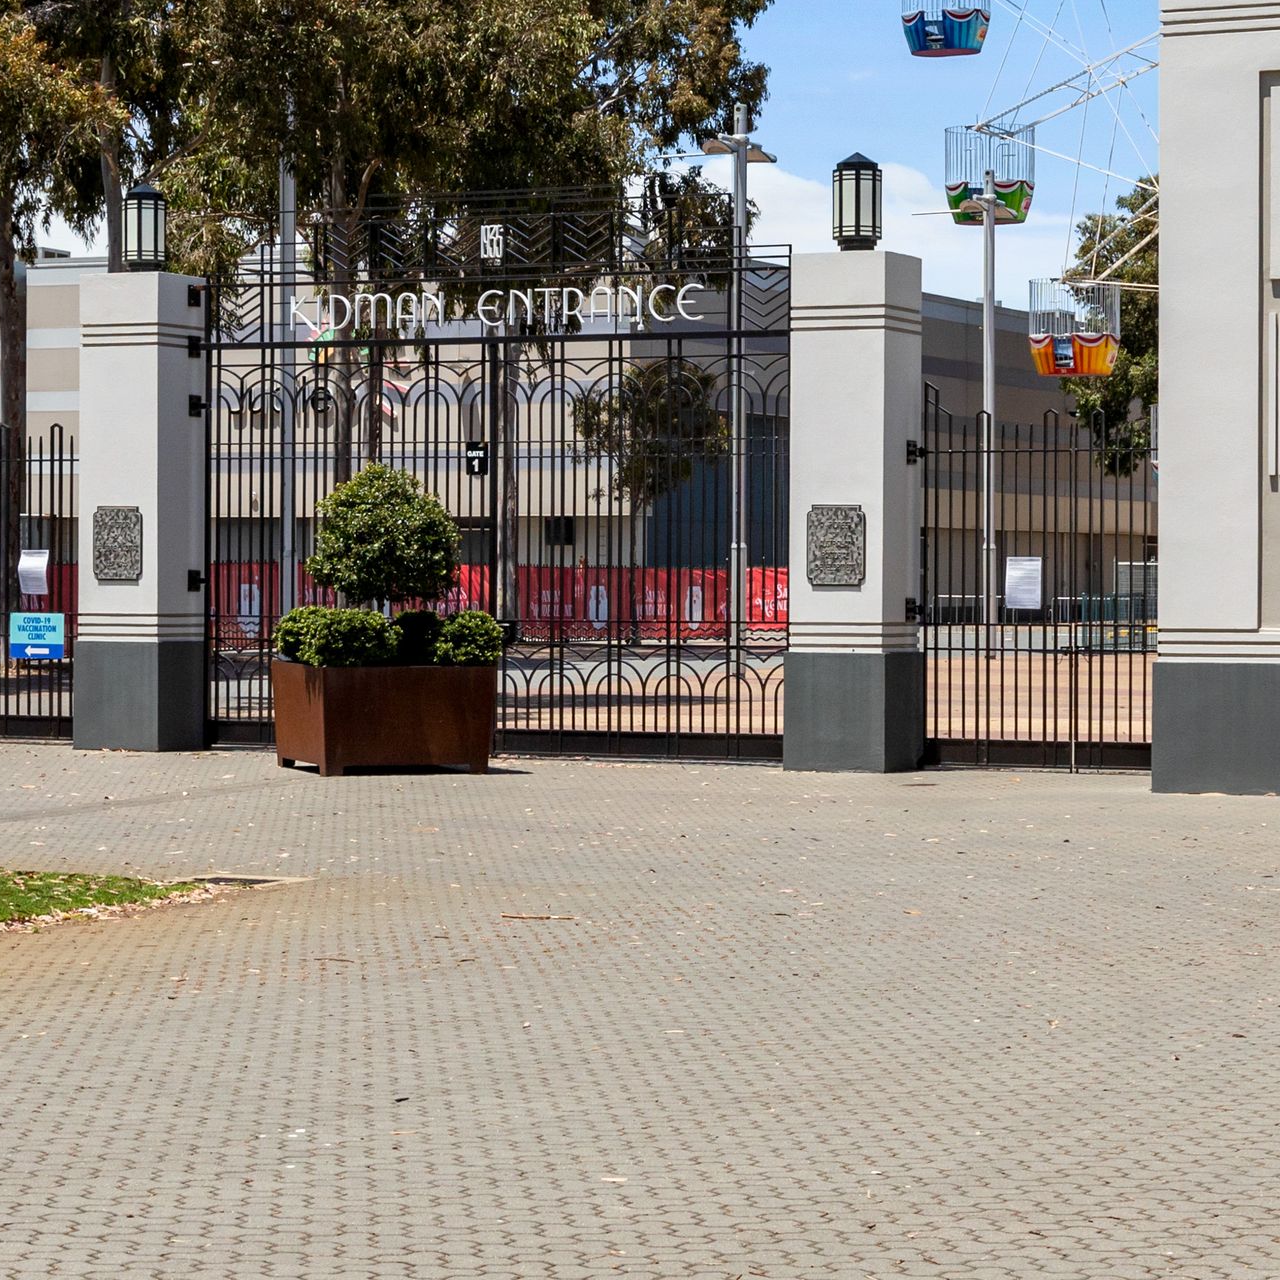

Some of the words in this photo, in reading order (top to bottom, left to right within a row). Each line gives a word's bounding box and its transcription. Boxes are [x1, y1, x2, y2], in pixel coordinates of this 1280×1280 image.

[289, 291, 446, 331] KIDMAN
[477, 283, 706, 327] ENTRANCE
[472, 458, 479, 472] 1
[23, 616, 51, 625] COVID-19
[17, 625, 57, 633] VACCINATION
[27, 633, 47, 641] CLINIC
